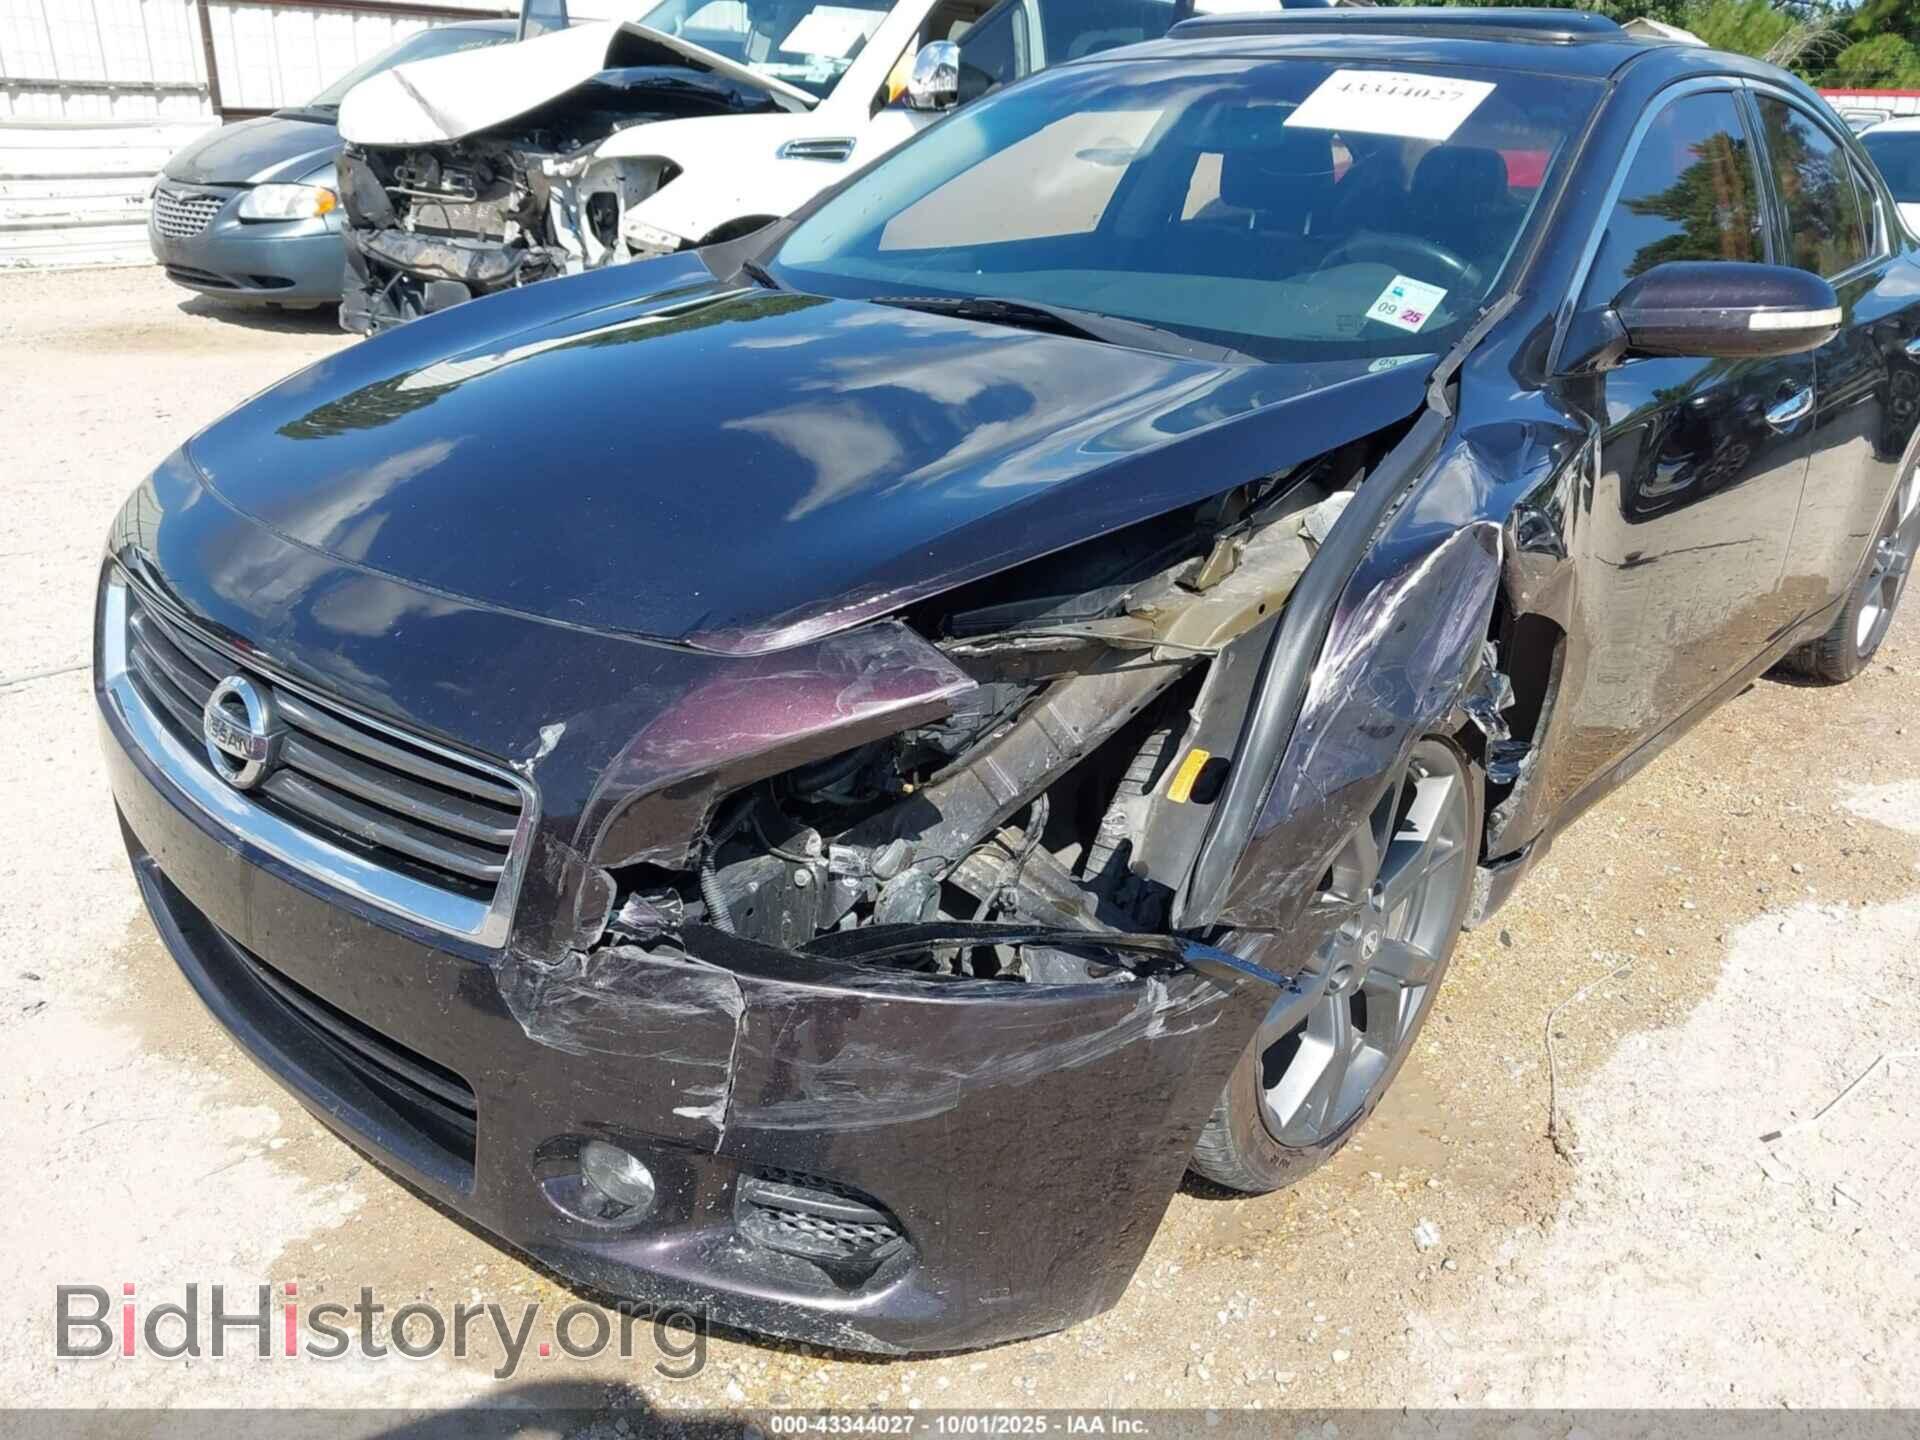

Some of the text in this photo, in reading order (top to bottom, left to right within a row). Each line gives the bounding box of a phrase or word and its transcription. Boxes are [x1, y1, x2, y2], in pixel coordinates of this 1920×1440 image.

[1378, 302, 1423, 323] 09 25
[207, 712, 254, 755] SSAN
